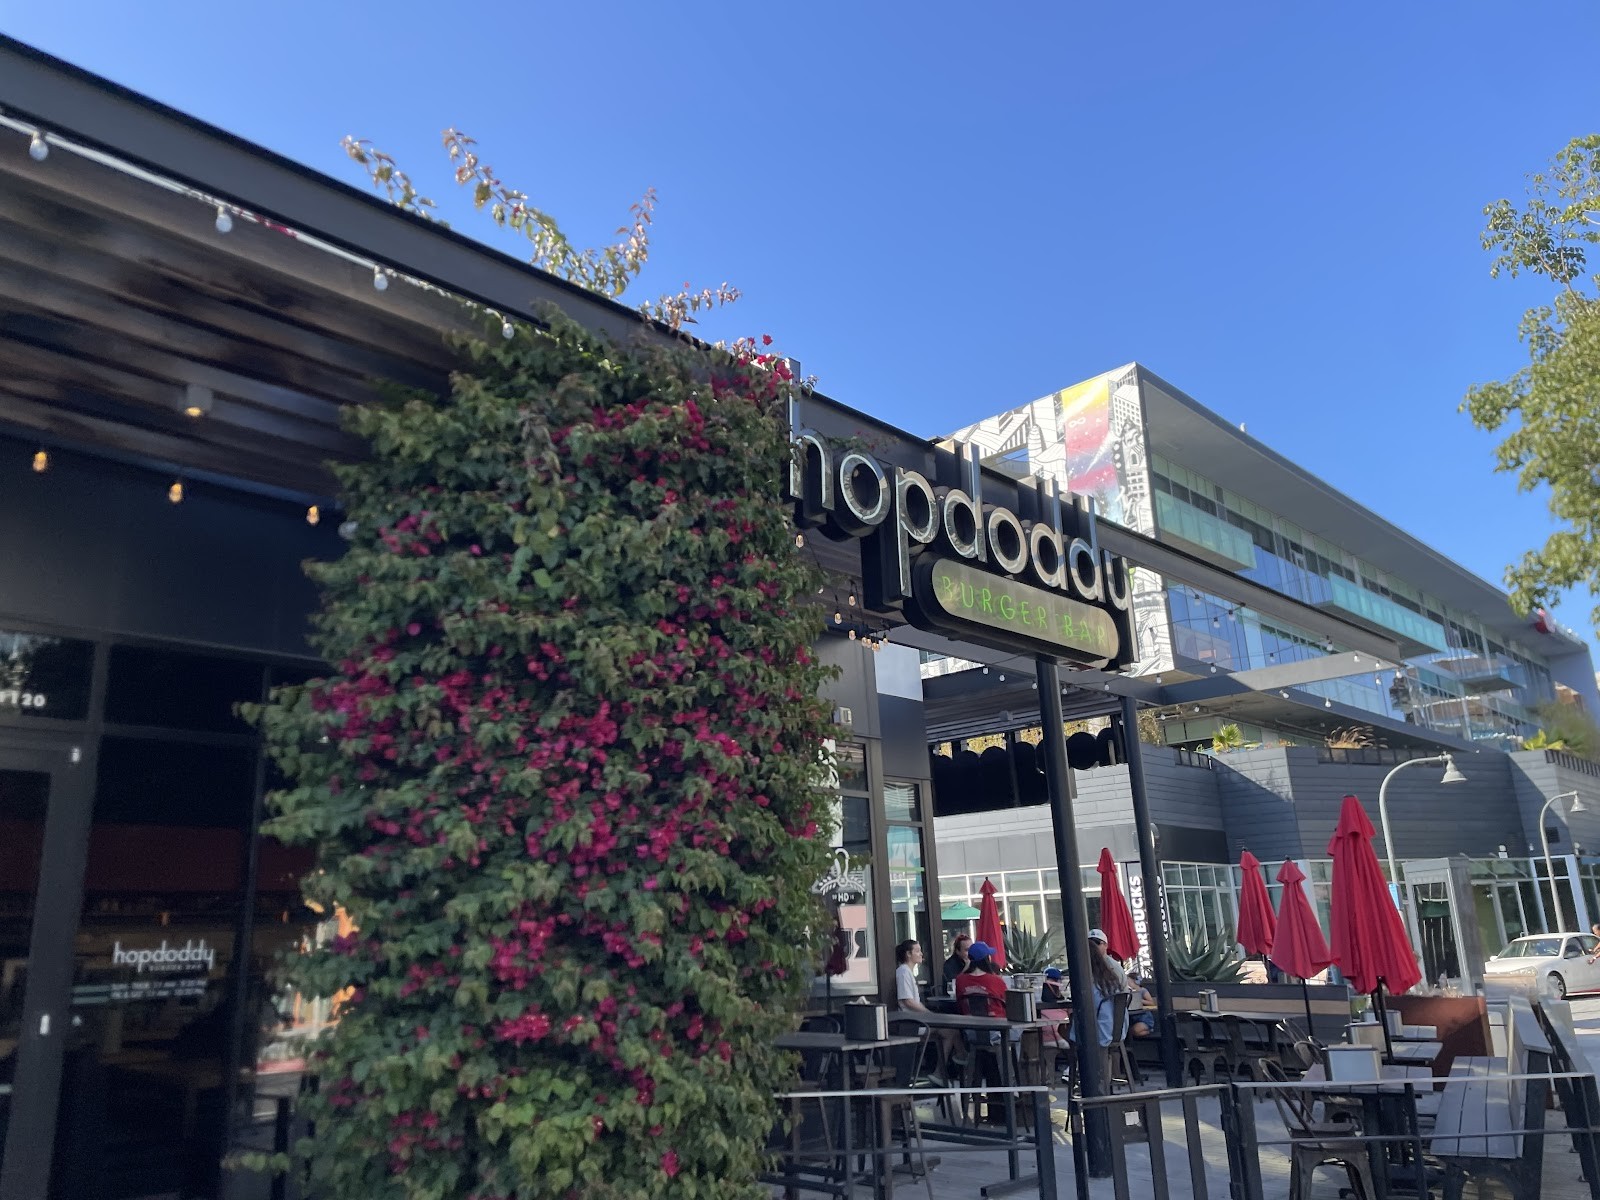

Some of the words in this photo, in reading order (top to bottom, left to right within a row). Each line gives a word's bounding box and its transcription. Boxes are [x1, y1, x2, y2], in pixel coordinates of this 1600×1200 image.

[788, 359, 1139, 662] hopdoddy
[941, 575, 1048, 629] BURGER
[1062, 613, 1106, 646] BAR
[113, 939, 214, 973] hopdoddy
[1129, 875, 1153, 979] STARBUCKS
